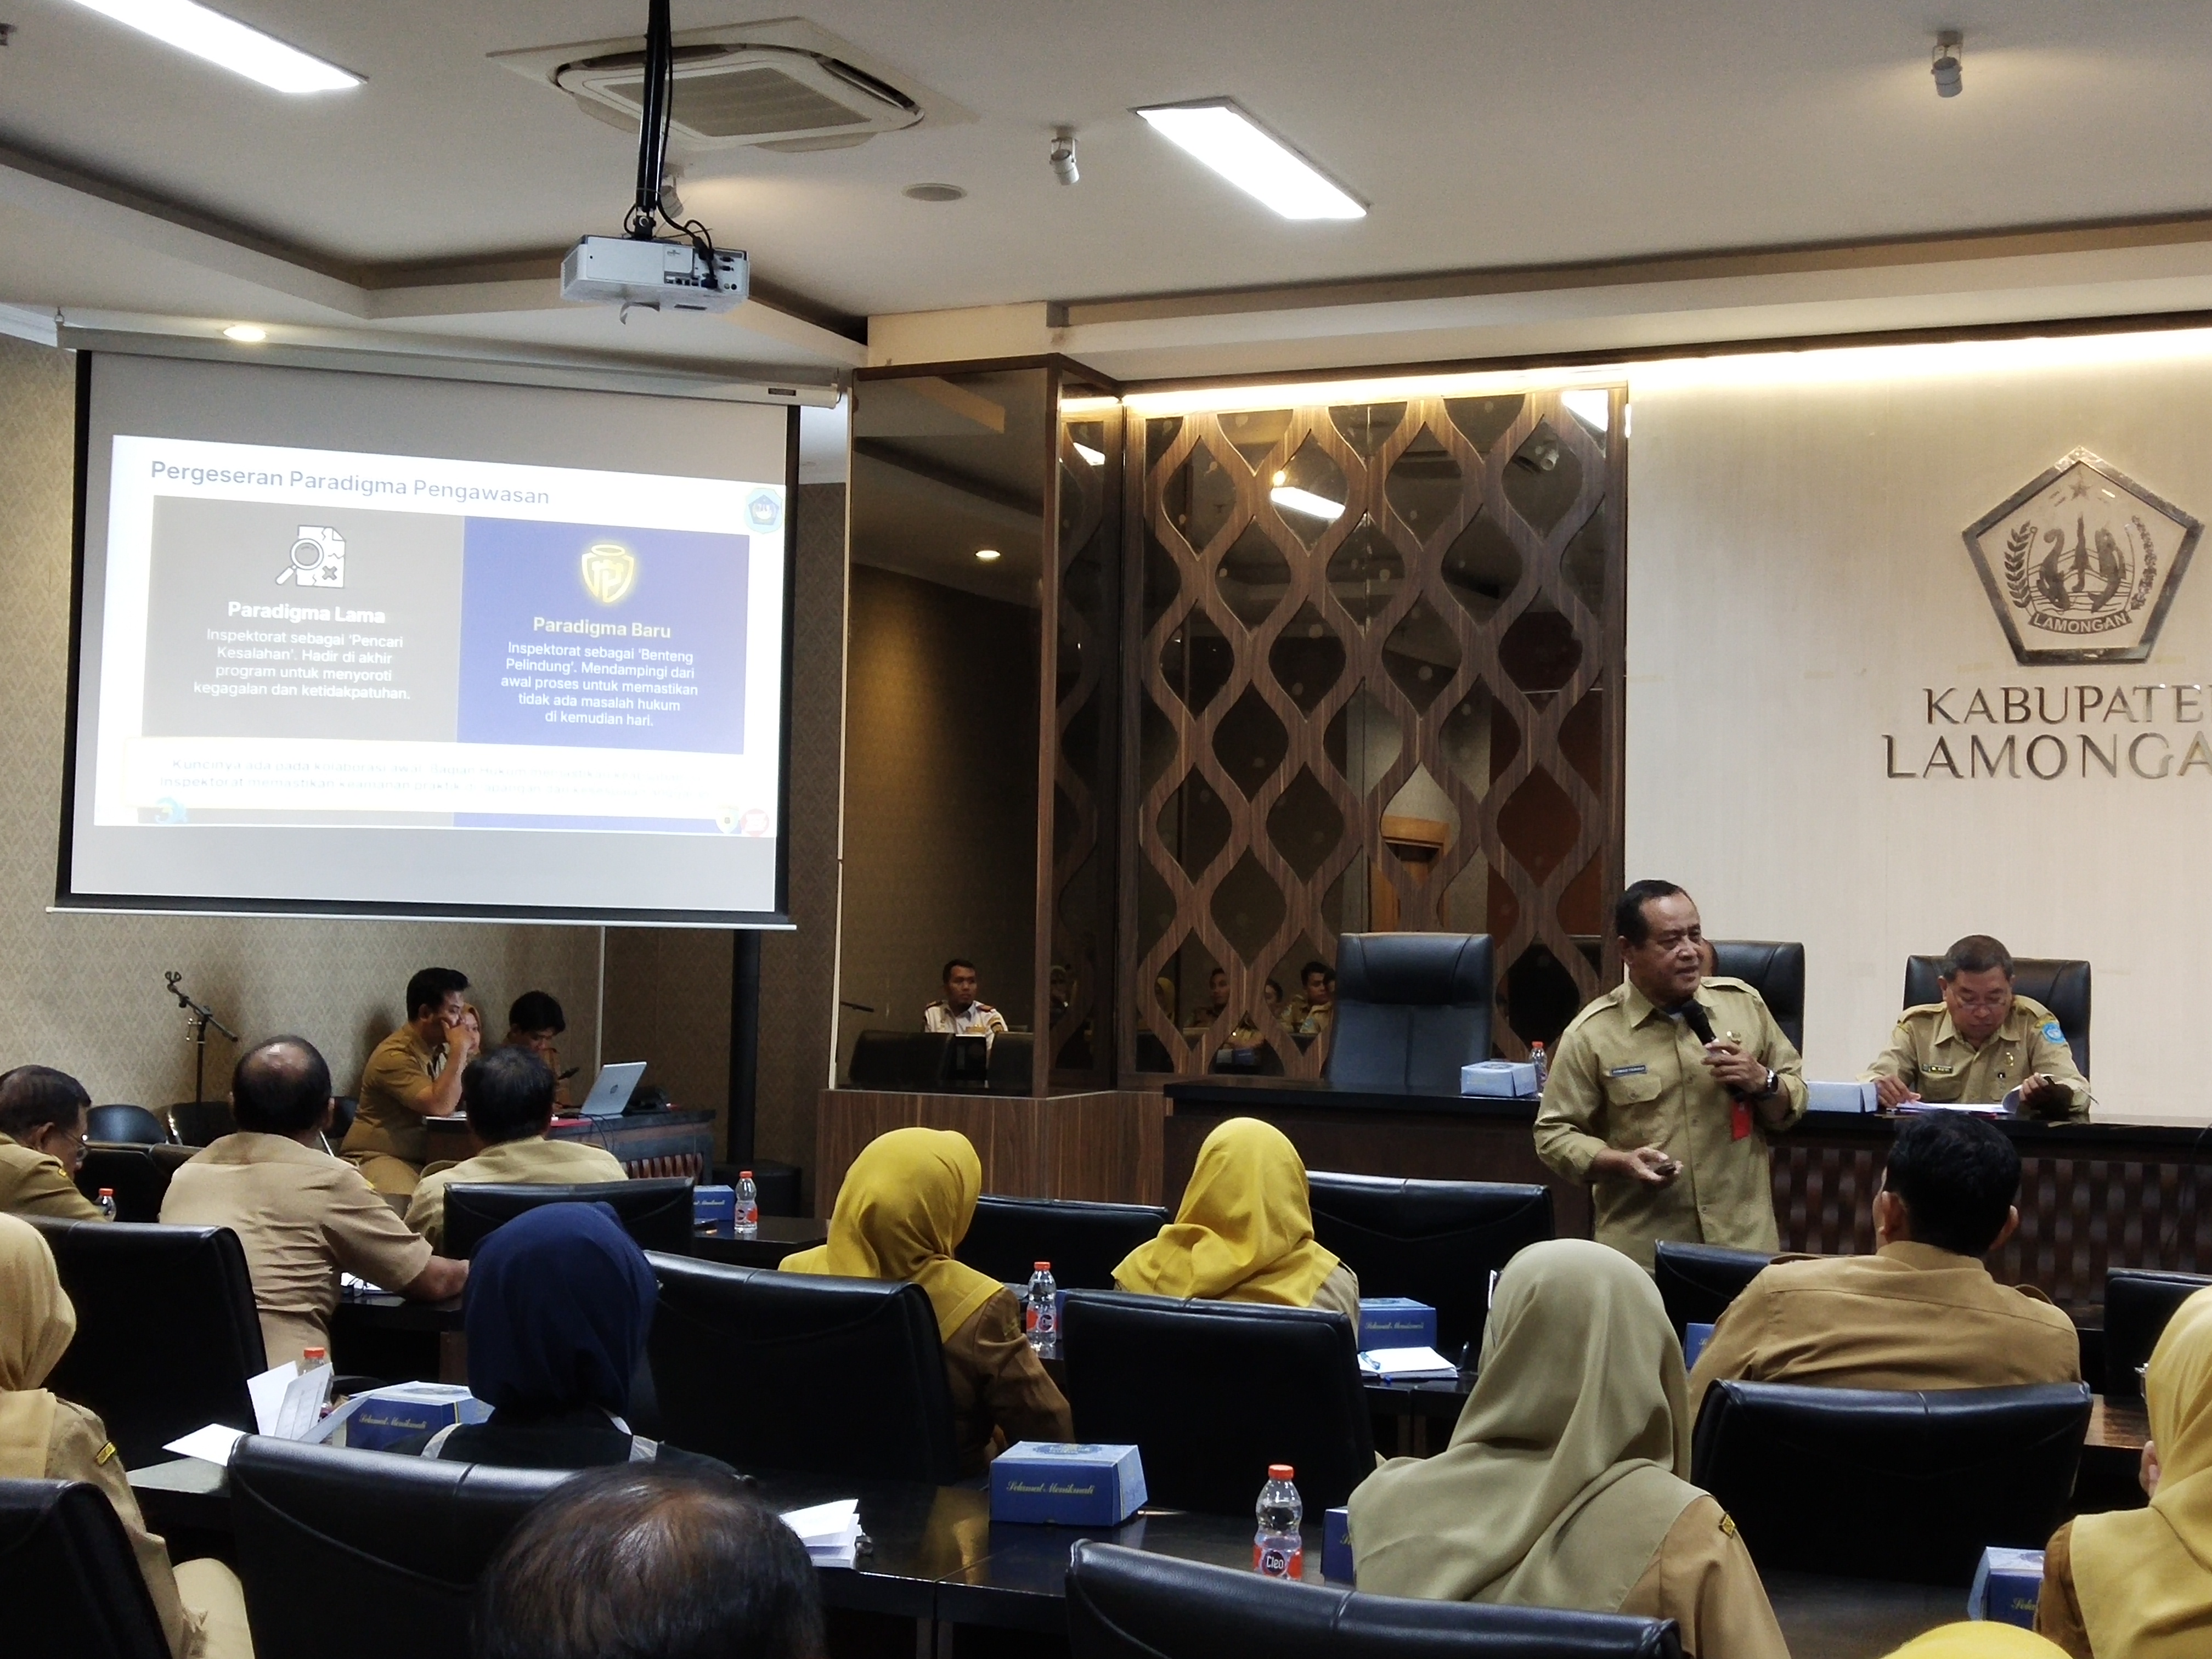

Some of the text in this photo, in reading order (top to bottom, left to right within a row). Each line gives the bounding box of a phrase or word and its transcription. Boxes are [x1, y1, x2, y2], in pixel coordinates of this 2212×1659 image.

[151, 460, 549, 504] Pergeseran Paradigma Pengawasan
[228, 601, 386, 624] Paradigma Lama
[533, 617, 671, 638] Paradigma Baru
[2033, 612, 2128, 634] LAMONGAN
[207, 629, 287, 644] Inspektorat
[291, 633, 345, 647] sebagai
[302, 650, 338, 662] Hadir
[342, 651, 355, 663] di
[359, 652, 392, 664] akhir
[508, 641, 580, 657] Inspektorat
[584, 646, 634, 661] sebagai
[216, 665, 392, 683] program untuk menyoroti
[581, 662, 668, 680] Mendampingi
[670, 667, 695, 679] dari
[193, 682, 410, 700] kegagalan dan ketidakpatuhan.
[501, 676, 698, 696] awal proses untuk memastikan
[518, 693, 680, 711] tidak ada masalah hukum
[1922, 684, 2212, 725] KABUPATE
[545, 710, 654, 726] di kemudian hari.
[1881, 730, 2212, 780] LAMONGA
[172, 759, 241, 771] Kuncinya
[245, 760, 272, 770] ada
[275, 761, 310, 772] pada
[160, 776, 244, 789] Inspektorat
[247, 777, 335, 789] memastikan
[1006, 1480, 1046, 1493] Selamat
[1266, 1555, 1284, 1570] Cleo
